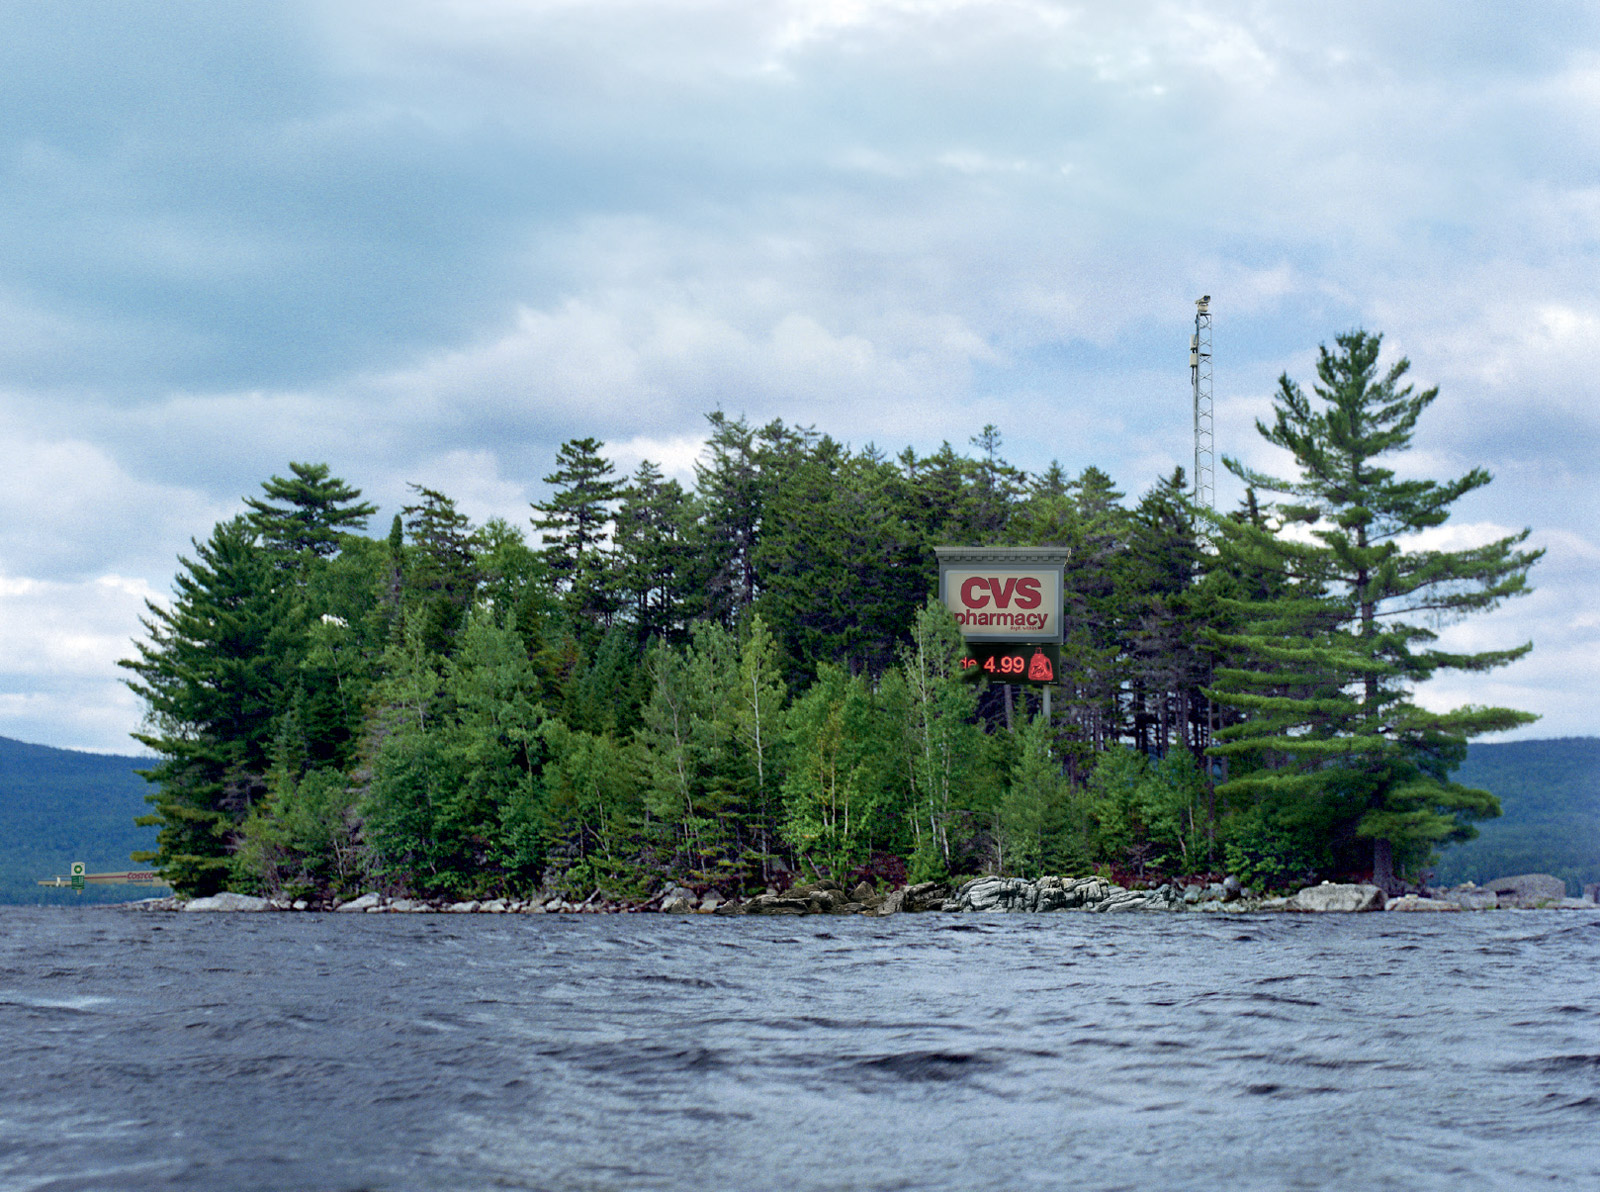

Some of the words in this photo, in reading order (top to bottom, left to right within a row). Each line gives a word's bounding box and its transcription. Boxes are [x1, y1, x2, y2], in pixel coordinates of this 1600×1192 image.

[961, 577, 1041, 609] CVS
[954, 609, 1048, 629] pharmacy
[983, 656, 1025, 673] 4.99
